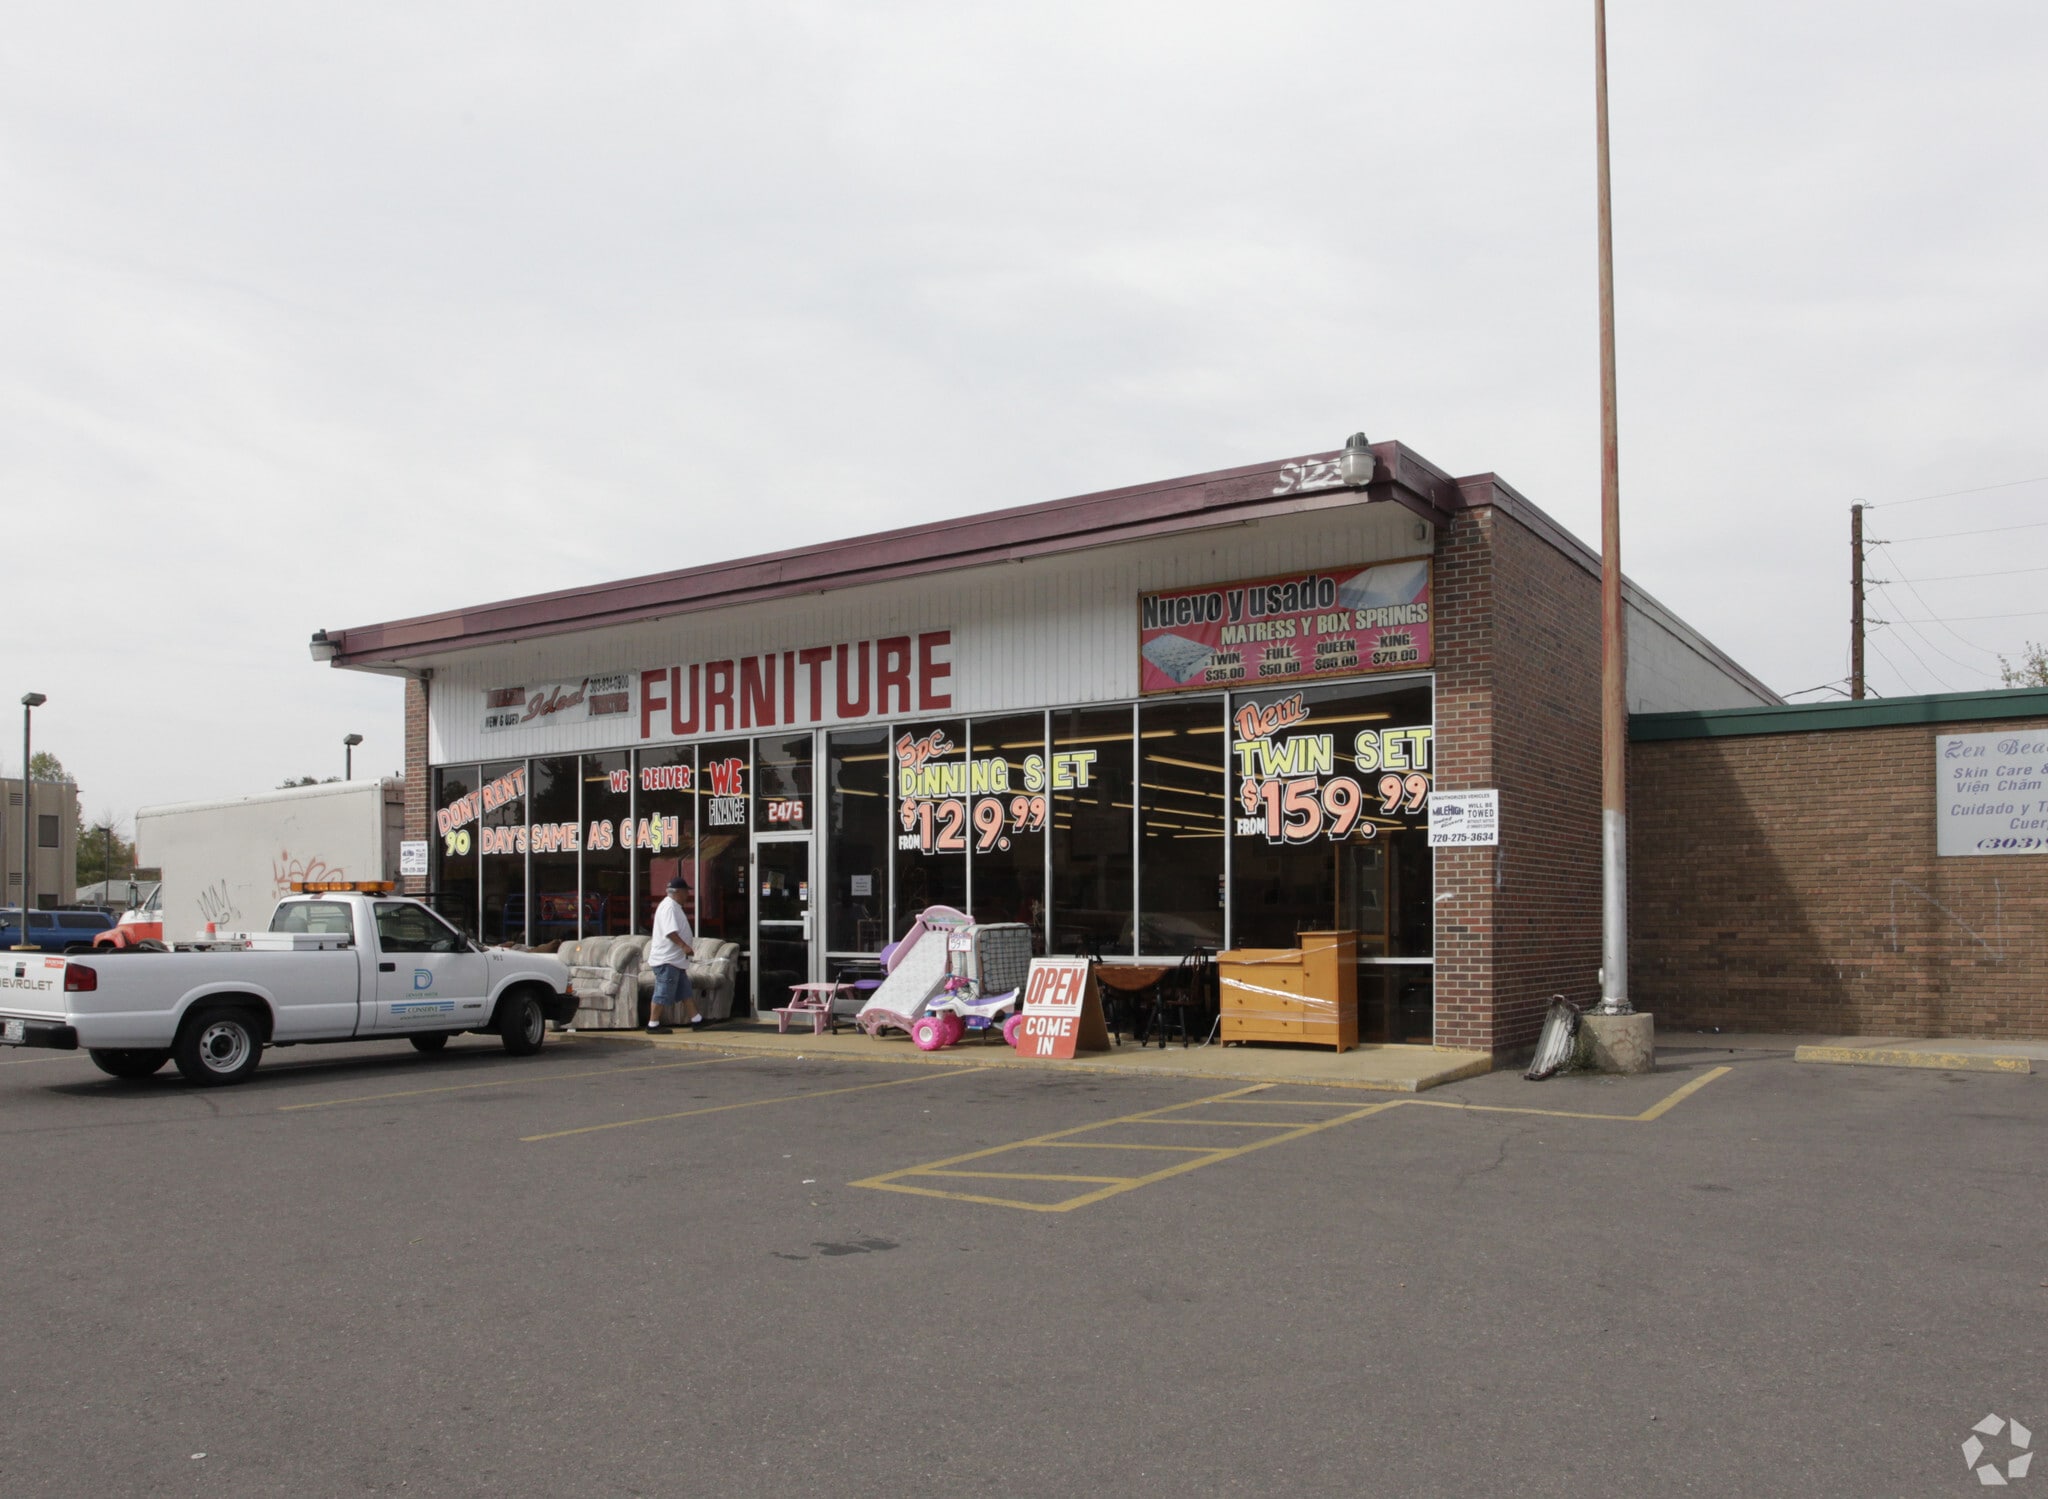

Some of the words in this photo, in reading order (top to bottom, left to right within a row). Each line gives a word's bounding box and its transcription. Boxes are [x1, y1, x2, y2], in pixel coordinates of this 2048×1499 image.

[1141, 592, 1222, 631] Nuevo
[1227, 590, 1244, 623] y
[1247, 575, 1335, 617] usado
[1220, 619, 1296, 646] MATRESS
[1300, 616, 1313, 637] Y
[1317, 611, 1352, 635] BOX
[1355, 602, 1429, 631] SPRINGS
[1317, 640, 1356, 655] QUEEN
[1380, 634, 1410, 648] KING
[1209, 651, 1241, 666] TWIN
[1265, 647, 1294, 660] FULL
[1372, 649, 1418, 665] $70.00
[1204, 666, 1246, 683] $35.00
[1258, 662, 1301, 677] $50.00
[640, 630, 952, 740] FURNITURE
[484, 714, 498, 729] NEW
[1235, 692, 1310, 742] New
[1233, 734, 1333, 780] TWIN
[1355, 726, 1434, 773] SET
[1944, 740, 1986, 759] Zen
[609, 769, 629, 793] WE
[642, 765, 691, 791] DELIVER
[709, 758, 743, 797] WE
[1024, 750, 1097, 792] SET
[1953, 767, 1988, 779] Skin
[1995, 765, 2033, 777] Care
[437, 790, 481, 837] DONT
[481, 766, 526, 814] RENT
[1951, 803, 2014, 816] Cuidado
[2020, 804, 2030, 816] y
[709, 797, 745, 826] FINANCE
[768, 800, 803, 822] 2475
[1467, 808, 1494, 818] TOWED
[1236, 817, 1266, 835] FROM
[2009, 817, 2048, 831] Cuer
[445, 829, 471, 856] 90
[481, 825, 526, 855] DAY'S
[531, 822, 579, 853] SAME
[587, 819, 613, 850] AS
[620, 812, 678, 853] CA$H
[898, 834, 922, 851] FROM
[1432, 832, 1494, 843] 720-275-3634
[0, 978, 53, 991] EVROLET
[1026, 967, 1086, 1005] OPEN
[1025, 1017, 1073, 1036] COME
[1036, 1036, 1055, 1055] IN
